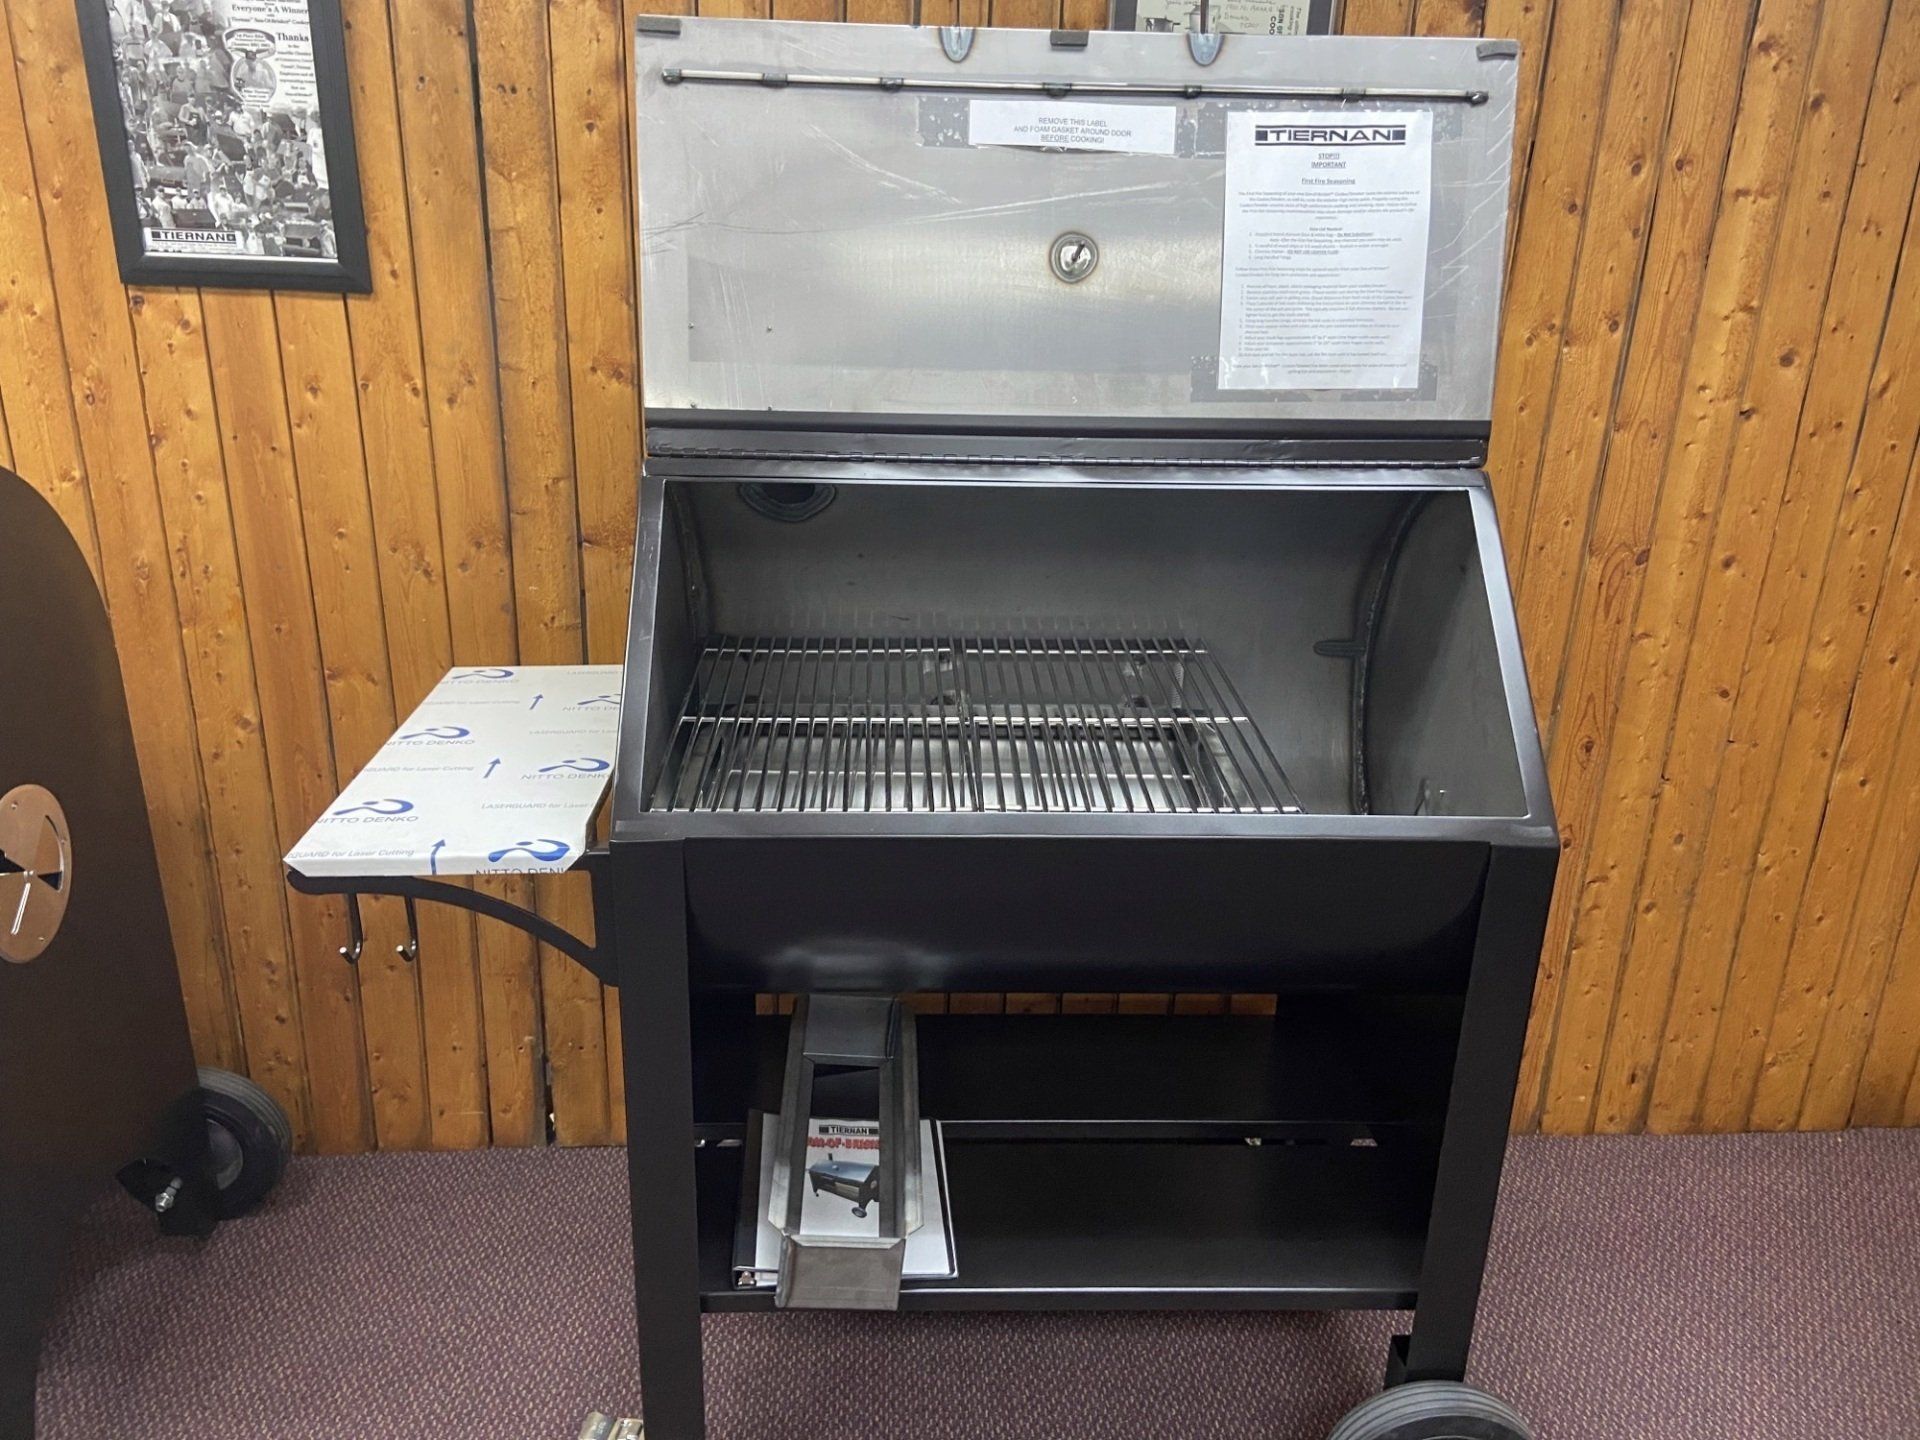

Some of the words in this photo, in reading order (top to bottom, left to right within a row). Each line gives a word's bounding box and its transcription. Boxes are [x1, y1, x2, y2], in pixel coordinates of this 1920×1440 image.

[276, 32, 309, 42] Thanks
[1038, 117, 1068, 125] REMOVE
[1070, 118, 1085, 126] THIS
[1086, 119, 1107, 127] LABEL
[1051, 126, 1079, 134] GASKET
[1080, 128, 1110, 136] AROUND
[1111, 129, 1131, 137] DOOR
[1269, 129, 1391, 141] TIERNAN
[1040, 134, 1069, 142] BEFORE
[1311, 161, 1346, 169] IMPORTANT
[162, 231, 225, 241] TIERNAN
[830, 1126, 868, 1134] TIERNAN
